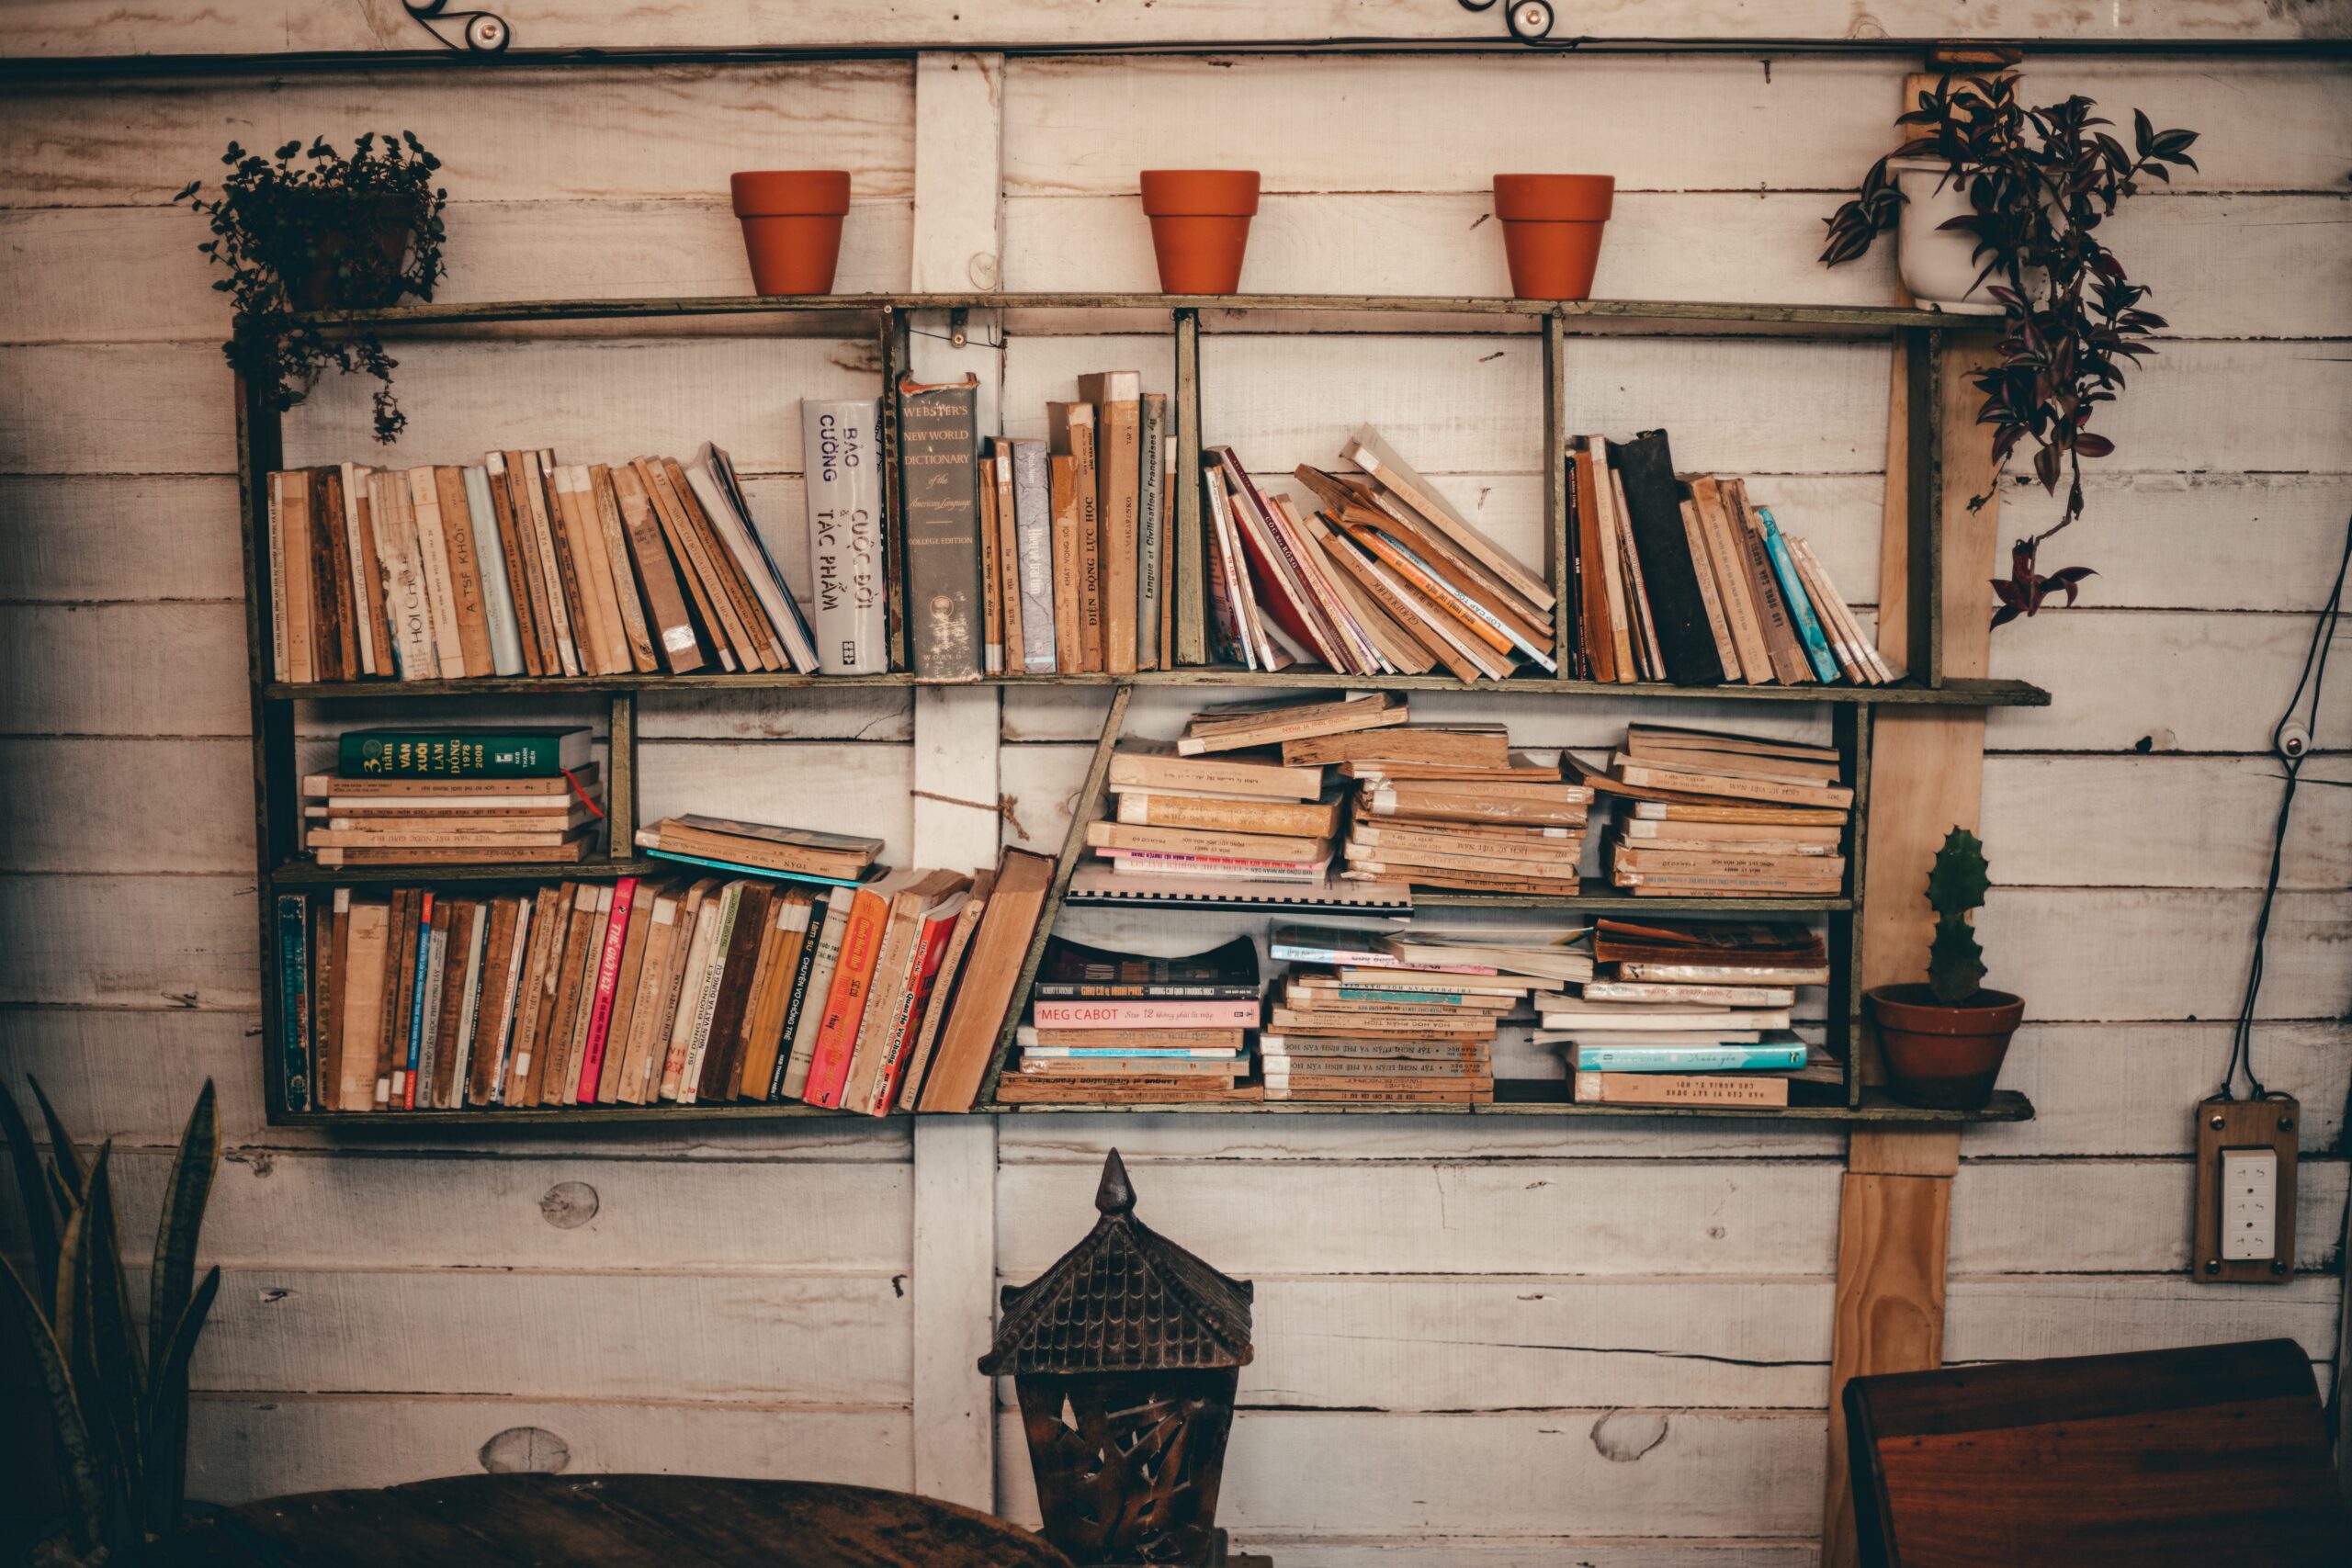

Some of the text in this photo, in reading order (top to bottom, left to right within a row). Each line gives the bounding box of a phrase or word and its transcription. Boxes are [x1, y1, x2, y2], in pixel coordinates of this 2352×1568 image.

[903, 405, 968, 416] WEBSTER'S
[904, 430, 968, 441] NEW WORLD
[905, 454, 970, 464] DICTIONARY
[926, 472, 948, 489] of the
[910, 497, 970, 510] American Language
[1085, 496, 1094, 521] HỌC
[1145, 491, 1156, 545] Civilisation
[1147, 548, 1154, 558] et
[1029, 579, 1045, 595] tim
[1144, 563, 1156, 598] Langue
[880, 930, 889, 951] GIAN
[532, 975, 540, 991] NAM
[672, 974, 681, 990] NAM
[902, 992, 914, 1013] Quan
[1042, 1009, 1118, 1020] MEG CABOT
[1144, 1008, 1154, 1018] 12
